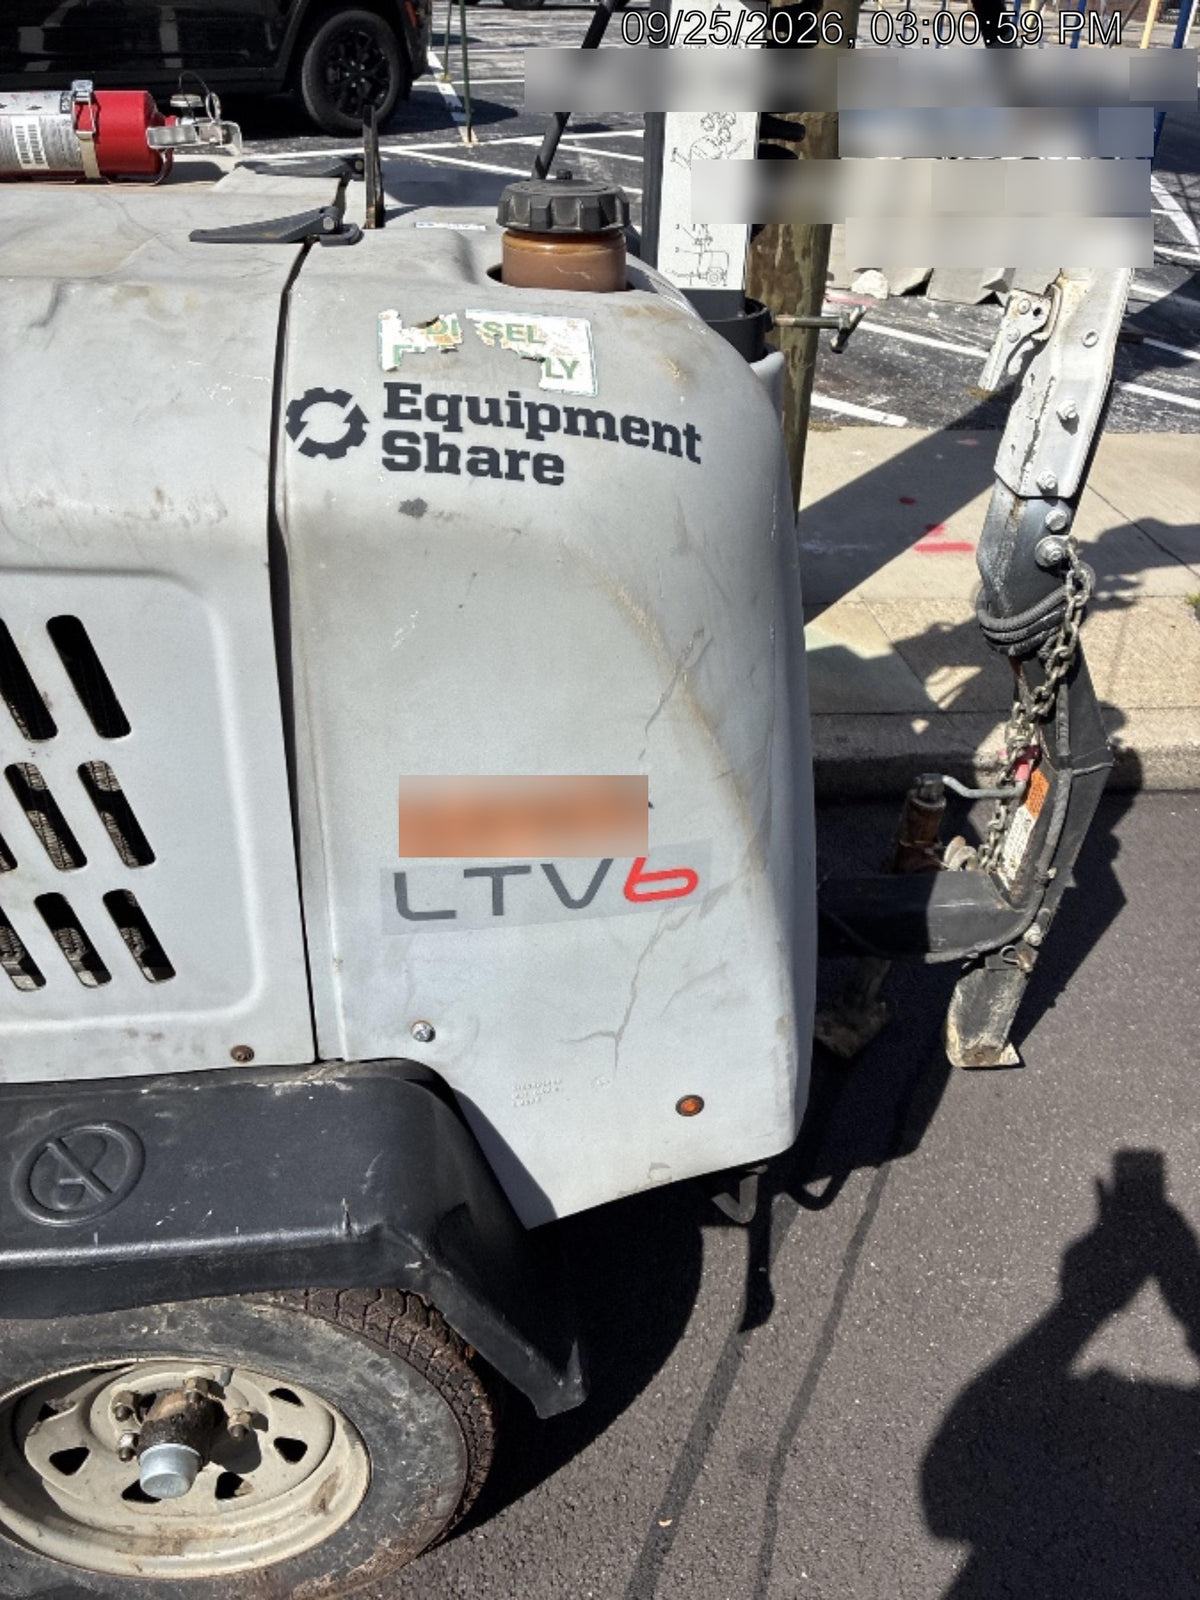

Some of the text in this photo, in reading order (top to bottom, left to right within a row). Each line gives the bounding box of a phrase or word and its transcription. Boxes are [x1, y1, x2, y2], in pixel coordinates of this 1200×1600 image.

[426, 318, 546, 344] DISEL
[383, 382, 702, 465] Equipment
[382, 430, 565, 486] Share
[393, 857, 699, 922] LTV6
